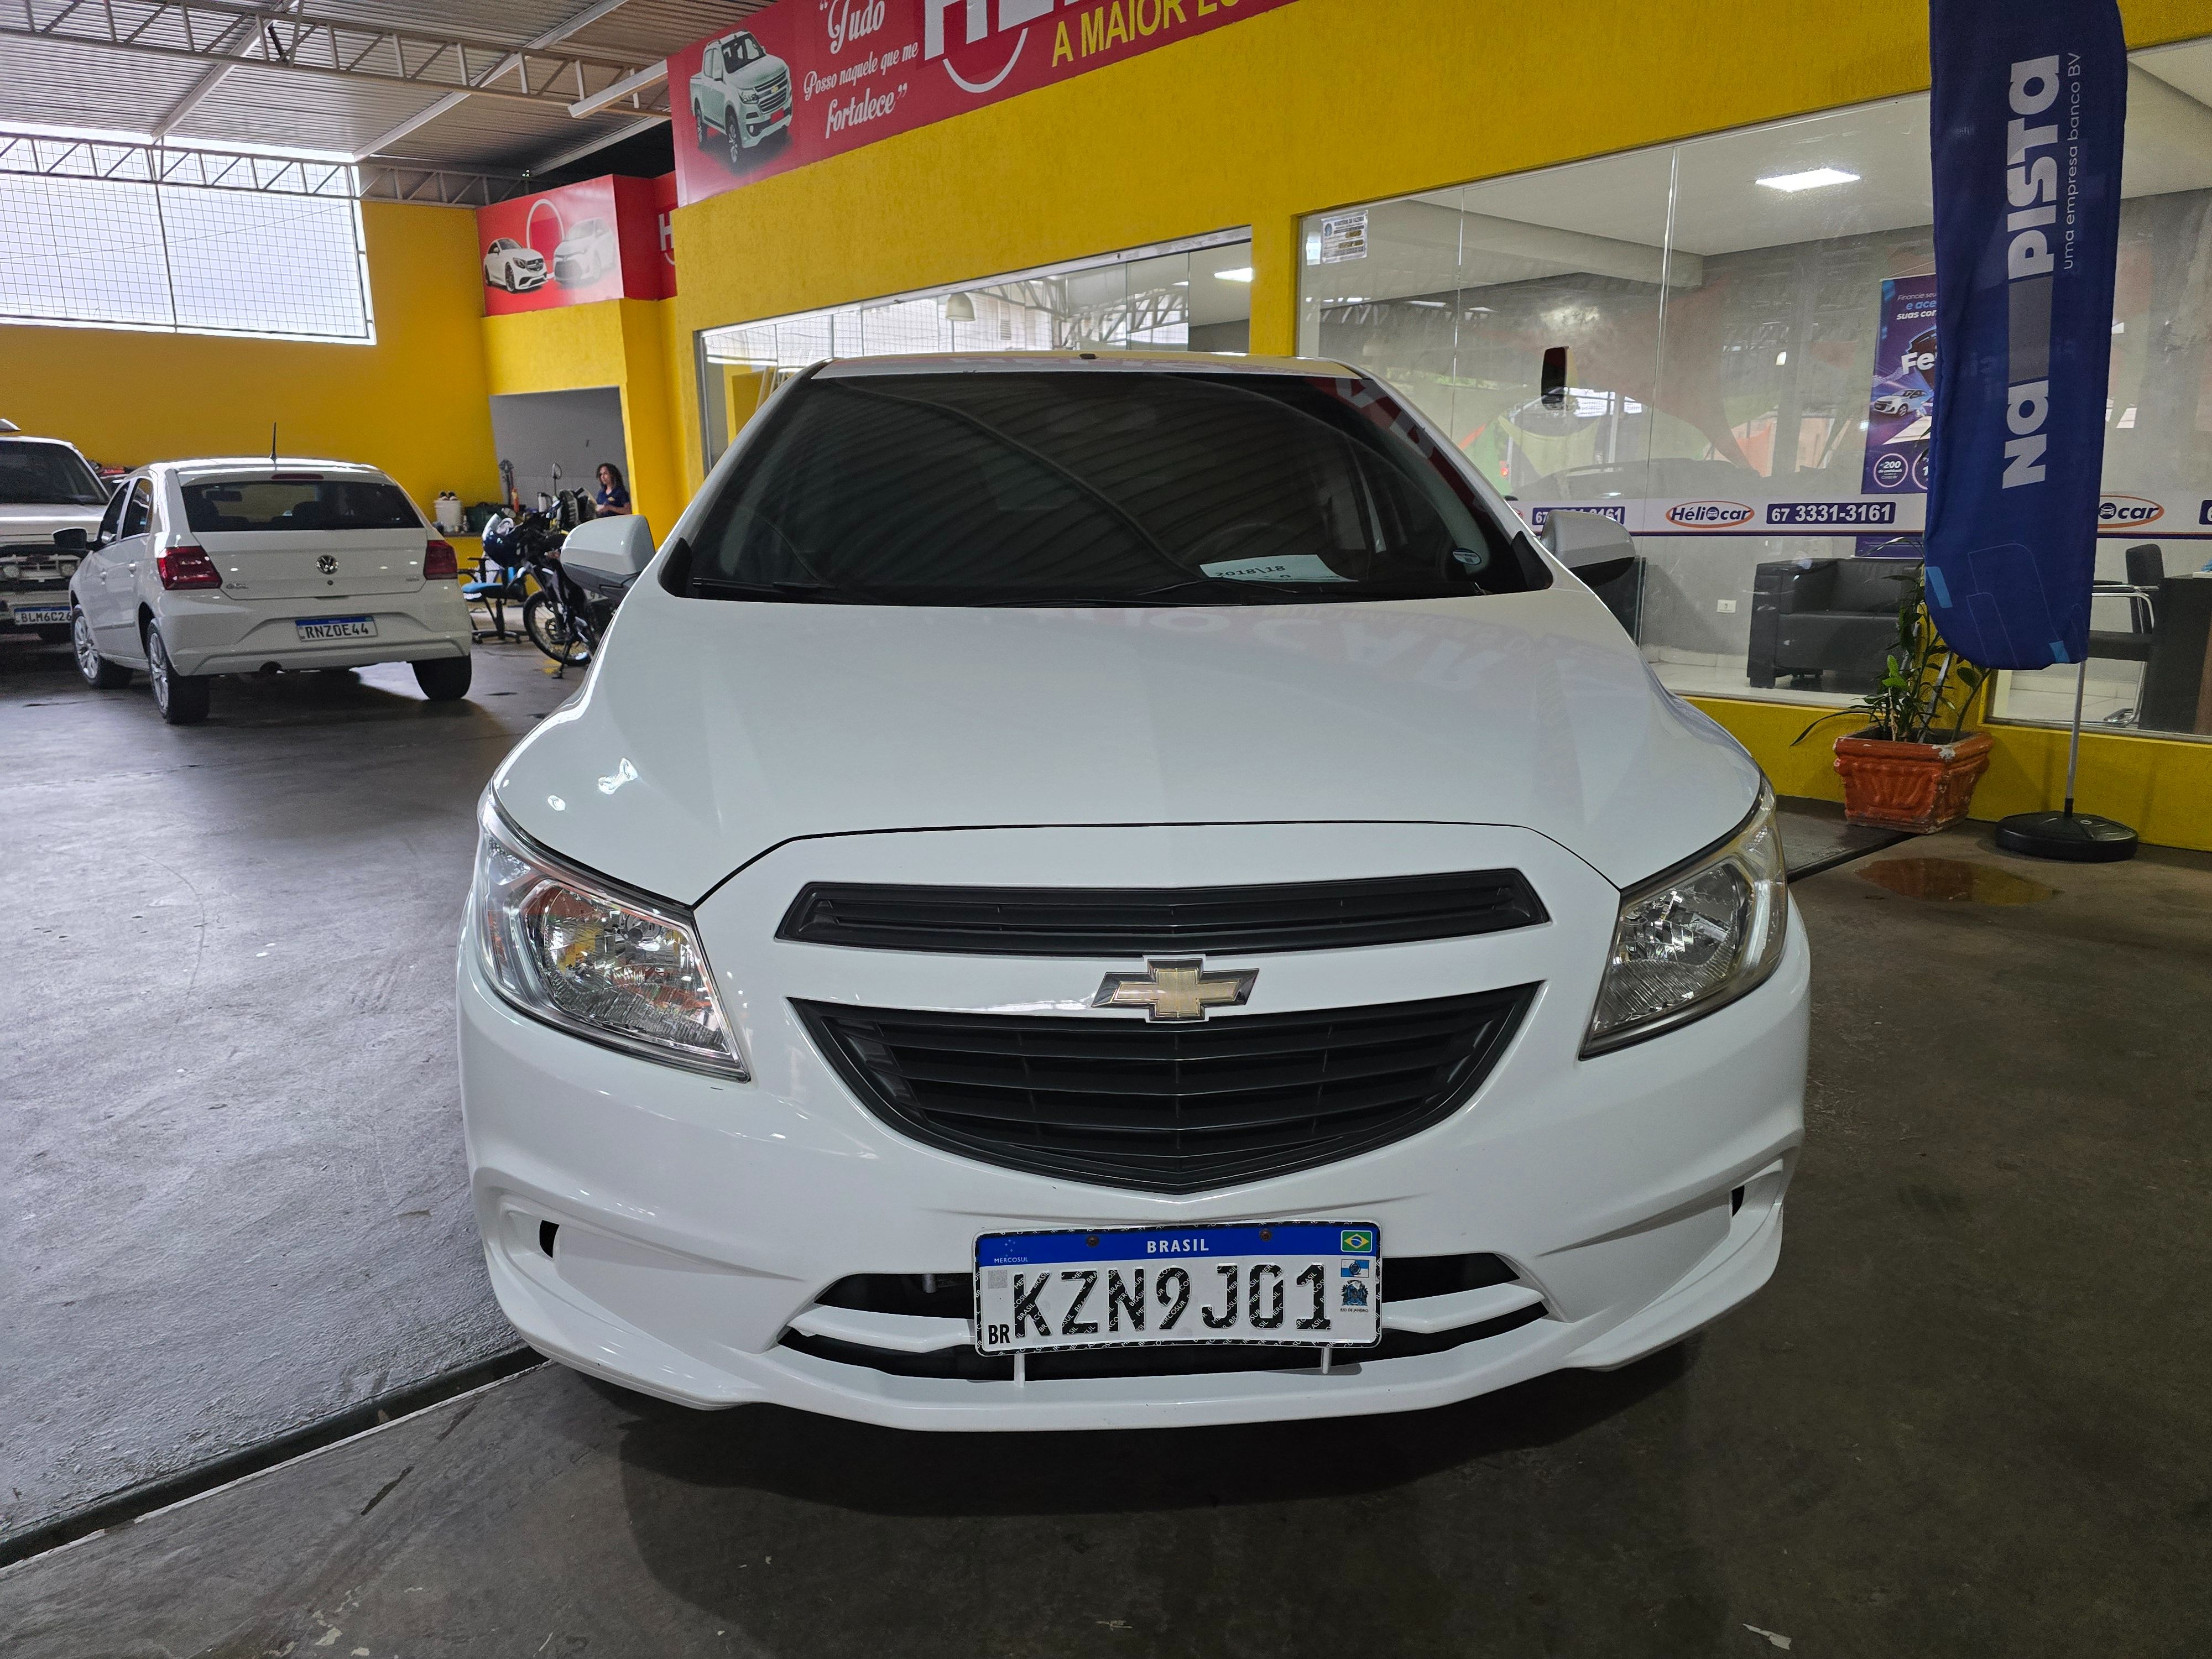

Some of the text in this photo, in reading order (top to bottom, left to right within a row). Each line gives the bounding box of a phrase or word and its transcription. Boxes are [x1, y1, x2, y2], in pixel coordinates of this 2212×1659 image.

[1052, 20, 1073, 67] A
[1081, 0, 1187, 58] MAIOR
[804, 42, 920, 101] Posso naquele que me
[2064, 53, 2083, 270] uma empresa banco BV
[1896, 311, 1919, 320] suas
[1906, 302, 1913, 310] e
[1901, 352, 1937, 375] Fe
[1771, 504, 1891, 521] 67 3331-3161
[1147, 1238, 1209, 1254] BRASIL
[1013, 1264, 1331, 1337] KZN9J01
[988, 1323, 1010, 1345] BR
